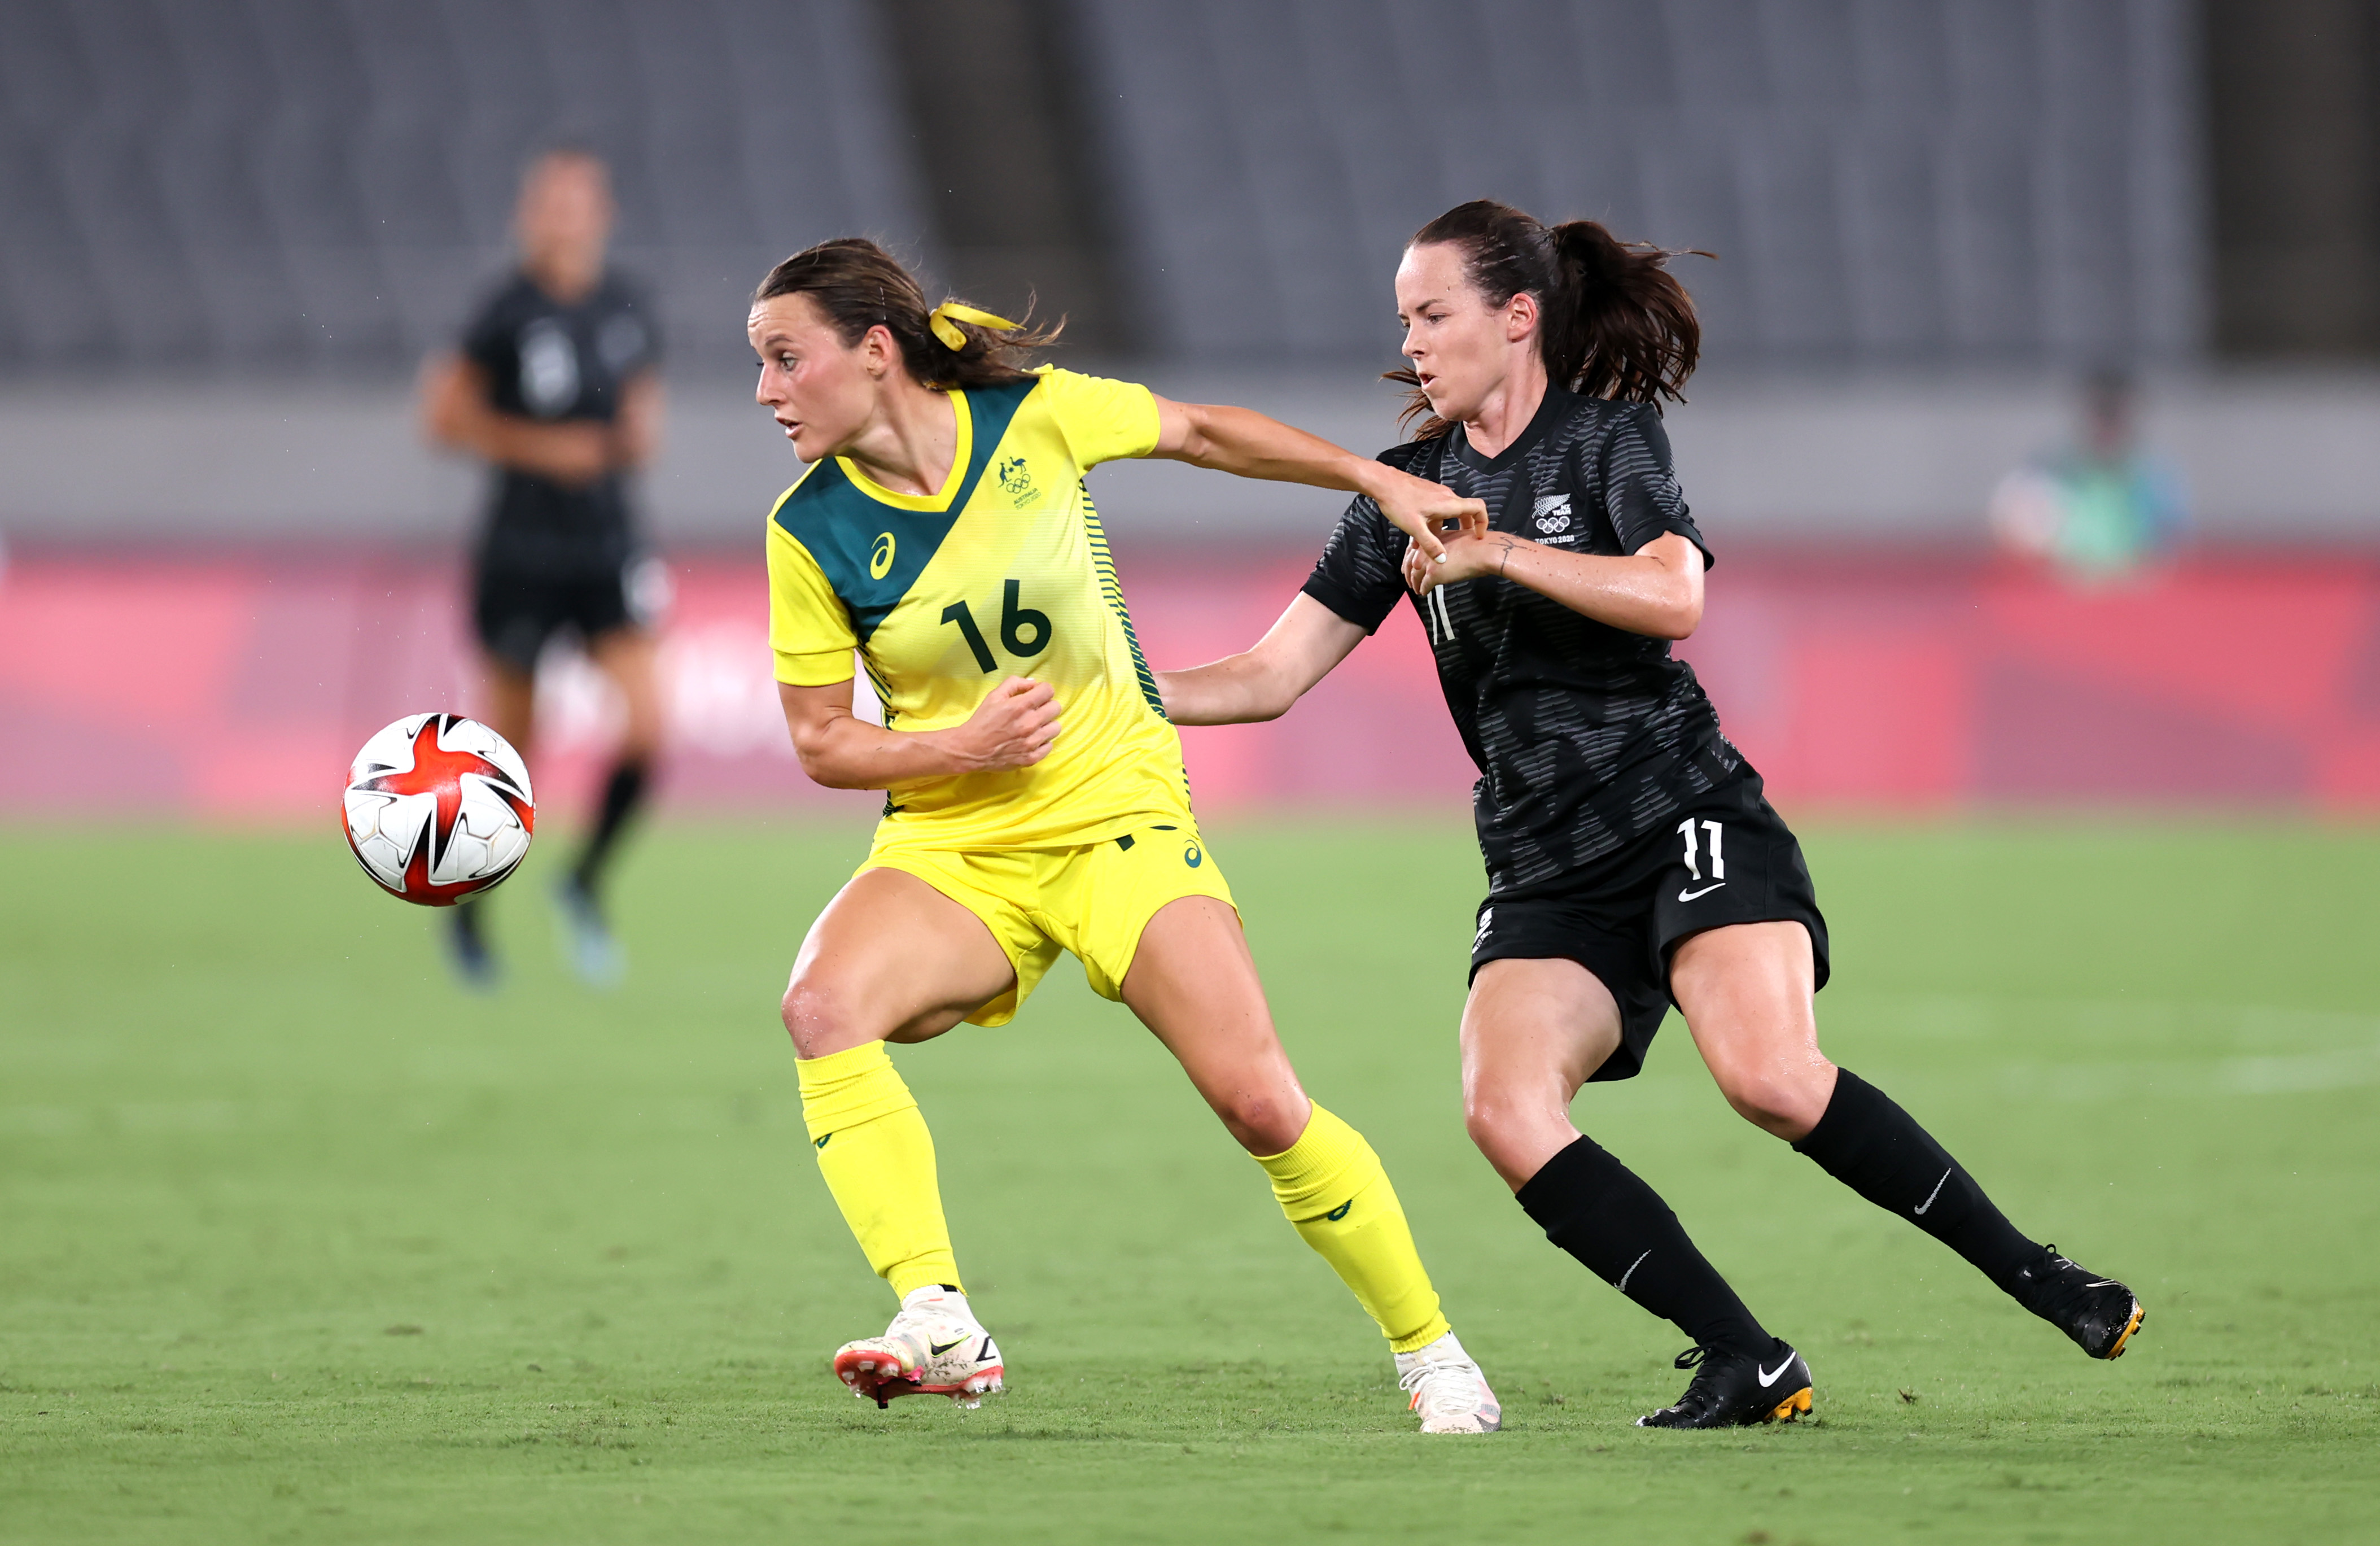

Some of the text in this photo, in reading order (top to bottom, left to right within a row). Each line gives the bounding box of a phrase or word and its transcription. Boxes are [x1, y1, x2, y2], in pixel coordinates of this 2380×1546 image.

[1014, 488, 1038, 505] AUSTRALIA
[1558, 535, 1575, 543] 2020
[940, 579, 1052, 674] 16
[1677, 817, 1725, 881] 11
